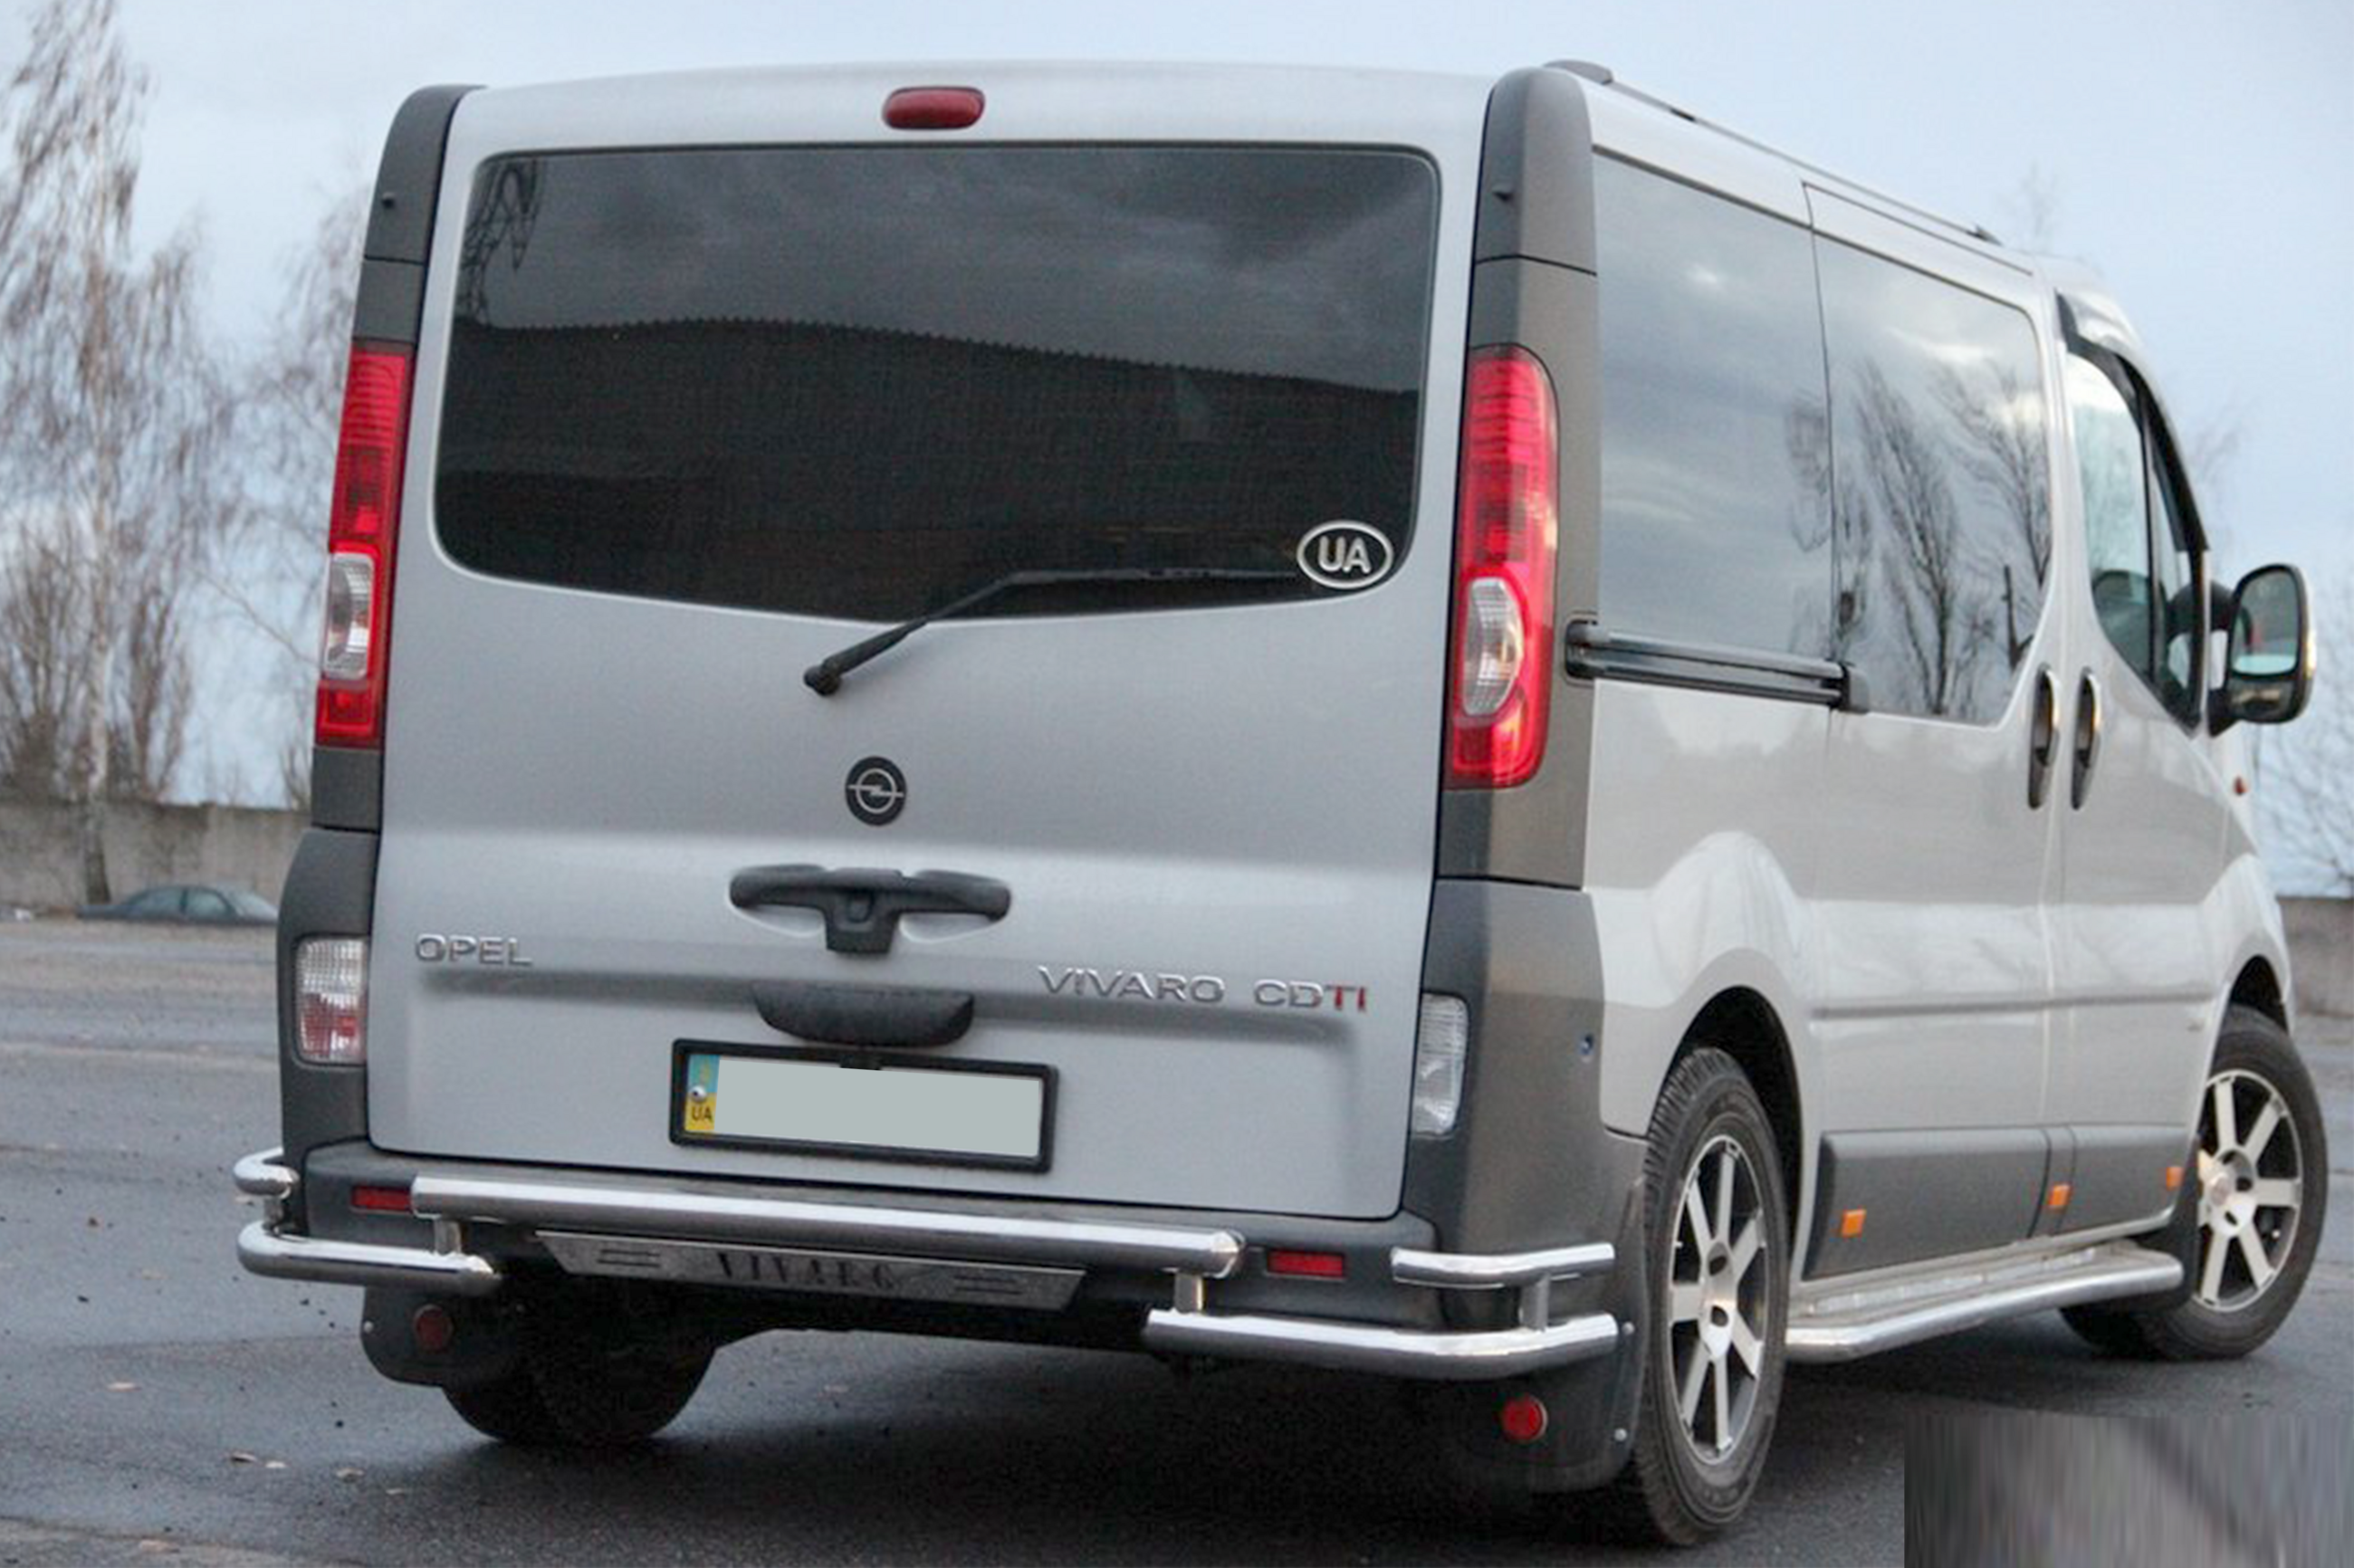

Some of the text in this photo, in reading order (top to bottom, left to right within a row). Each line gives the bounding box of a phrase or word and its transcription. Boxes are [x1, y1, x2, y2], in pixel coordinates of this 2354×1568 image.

[1318, 535, 1372, 574] UA
[416, 933, 533, 967] OPEL
[1038, 965, 1368, 1012] VIVARO CDTI
[691, 1105, 713, 1123] UA
